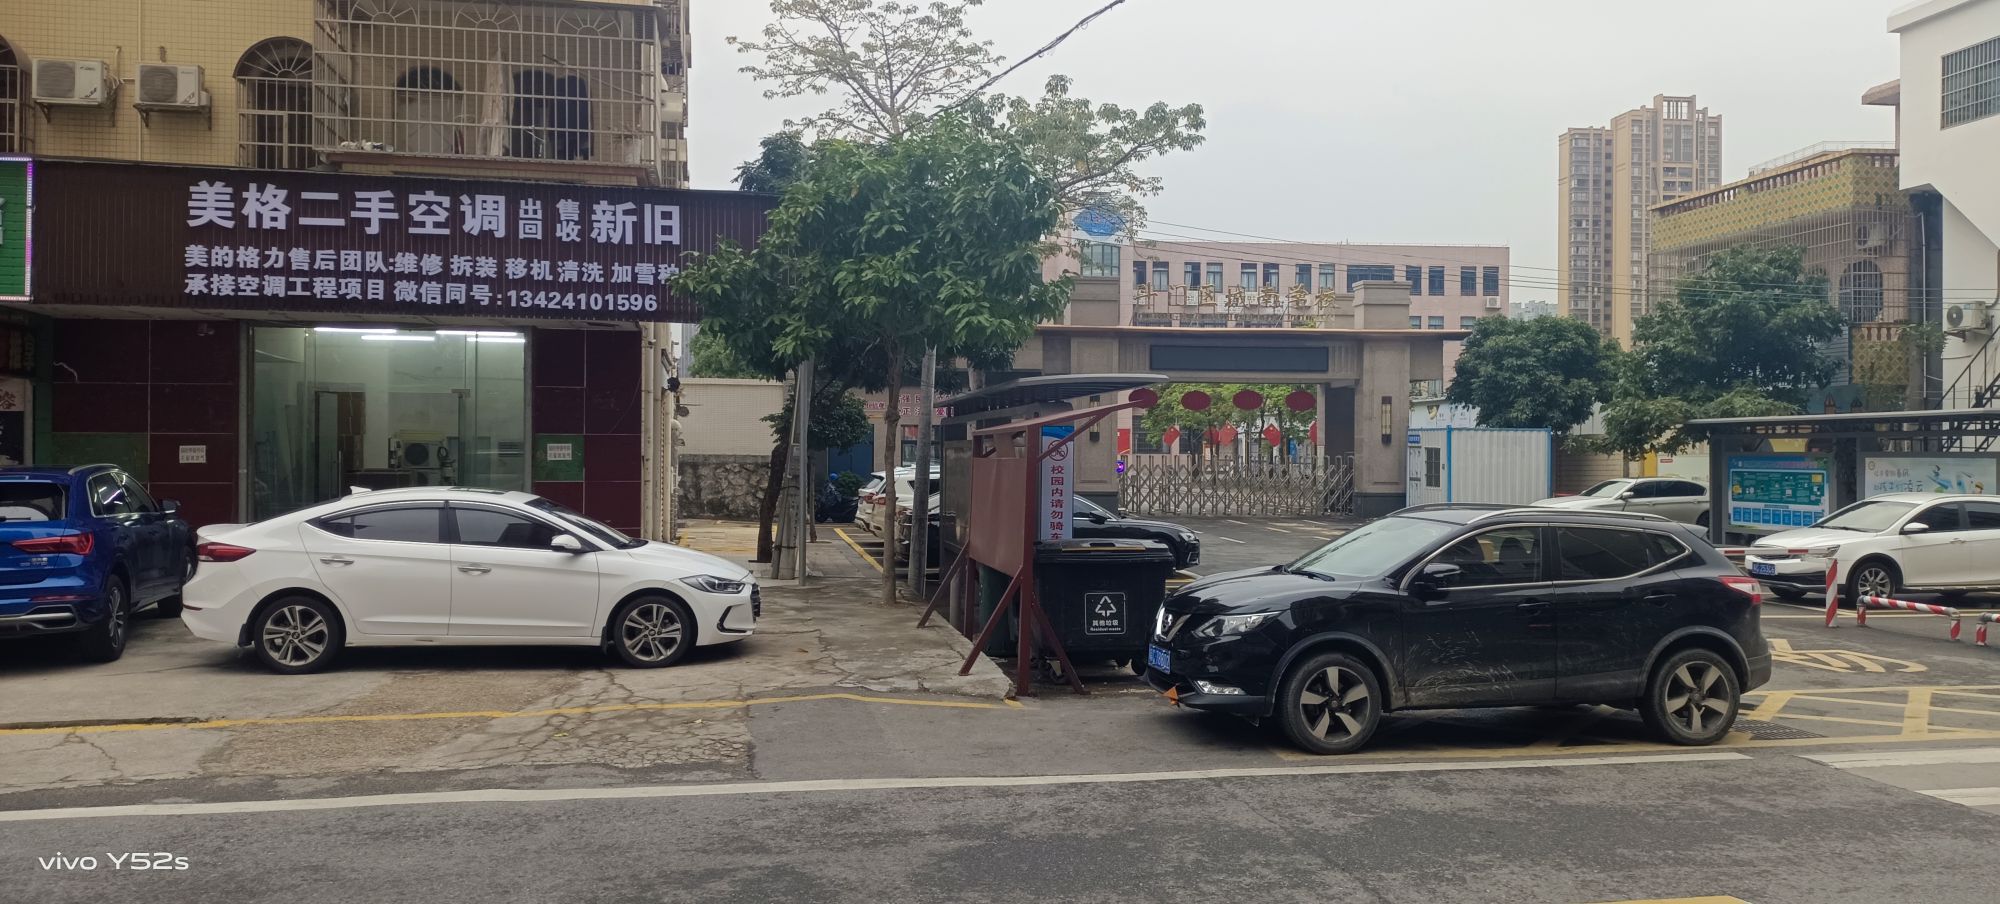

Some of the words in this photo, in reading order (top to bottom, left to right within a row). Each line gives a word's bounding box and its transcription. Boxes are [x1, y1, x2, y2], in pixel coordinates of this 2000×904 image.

[186, 180, 506, 238] 美格二手空调
[590, 200, 681, 246] 新旧
[184, 274, 386, 300] 承接空调工程项目
[450, 254, 498, 279] 拆装
[505, 258, 554, 281] 移机
[557, 259, 604, 283] 清洗
